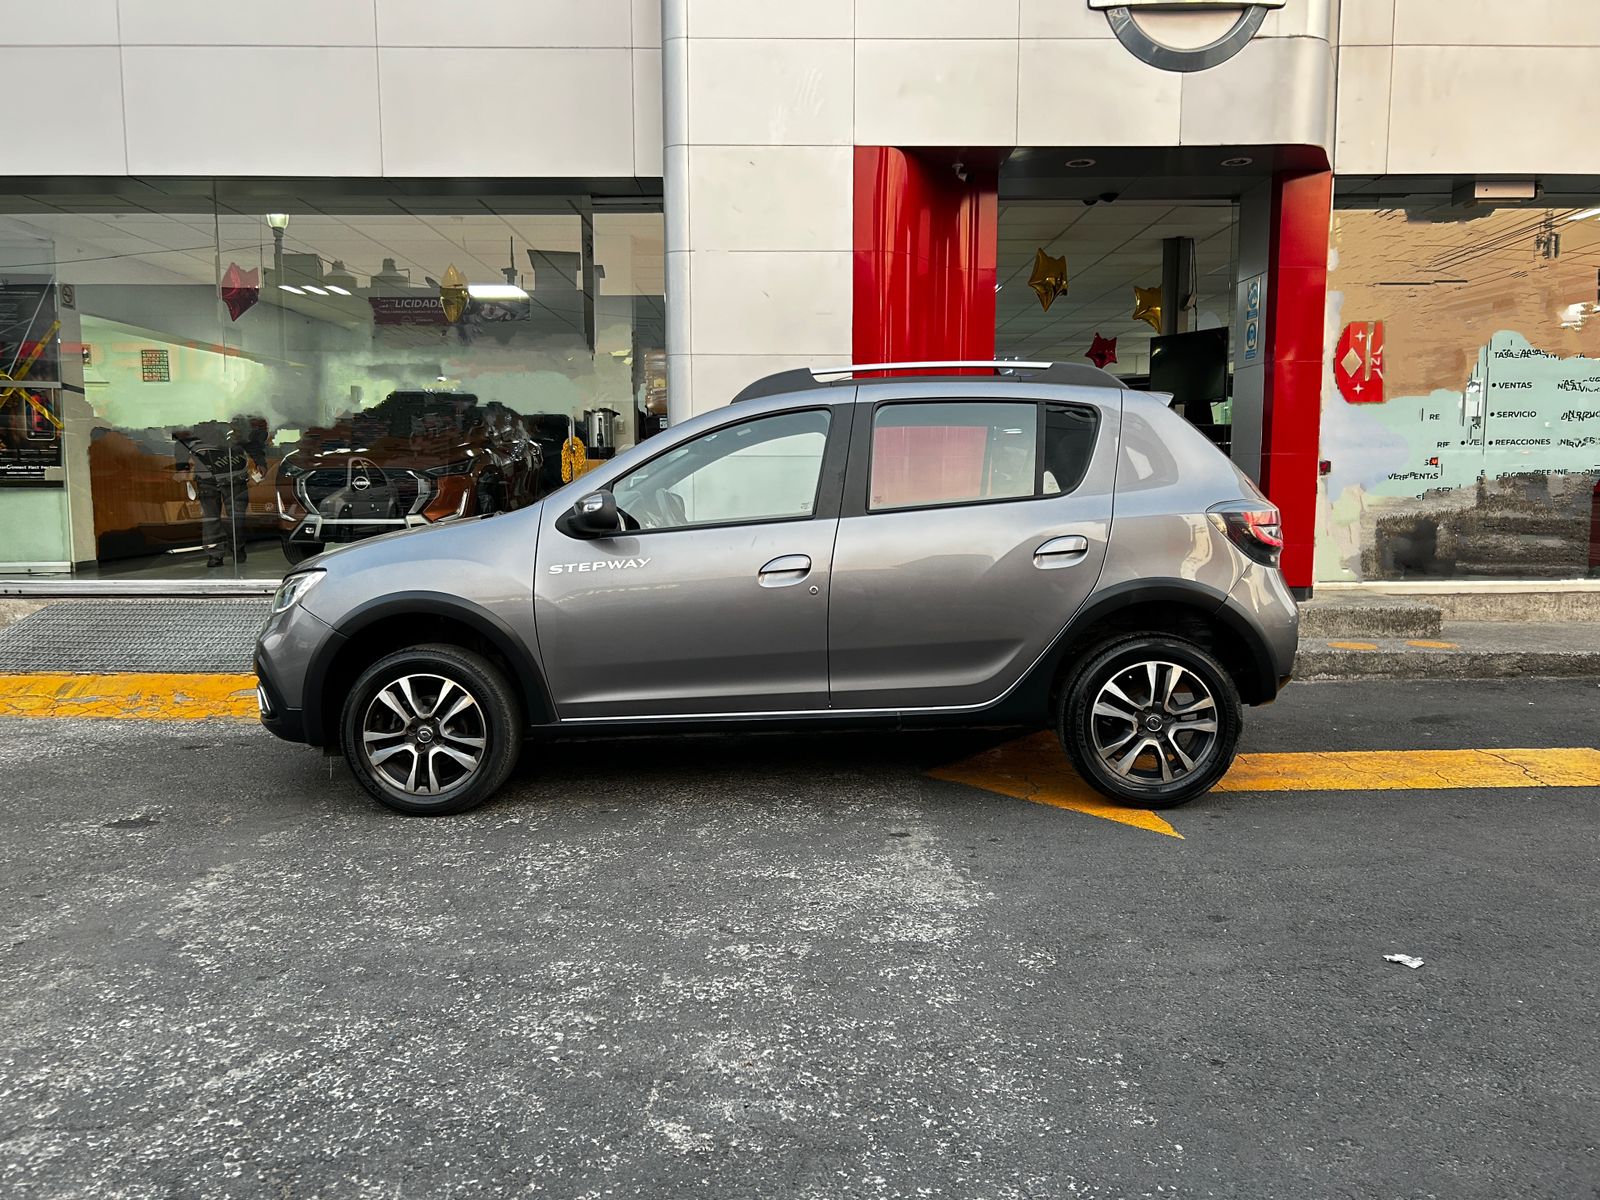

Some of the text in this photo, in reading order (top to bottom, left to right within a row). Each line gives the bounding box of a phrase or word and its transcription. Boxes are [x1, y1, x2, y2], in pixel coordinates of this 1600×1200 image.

[1498, 381, 1533, 389] VENTAS
[1496, 410, 1537, 418] SERVICIO
[1495, 438, 1551, 446] REFACCIONES
[548, 557, 652, 575] STEPWAY
